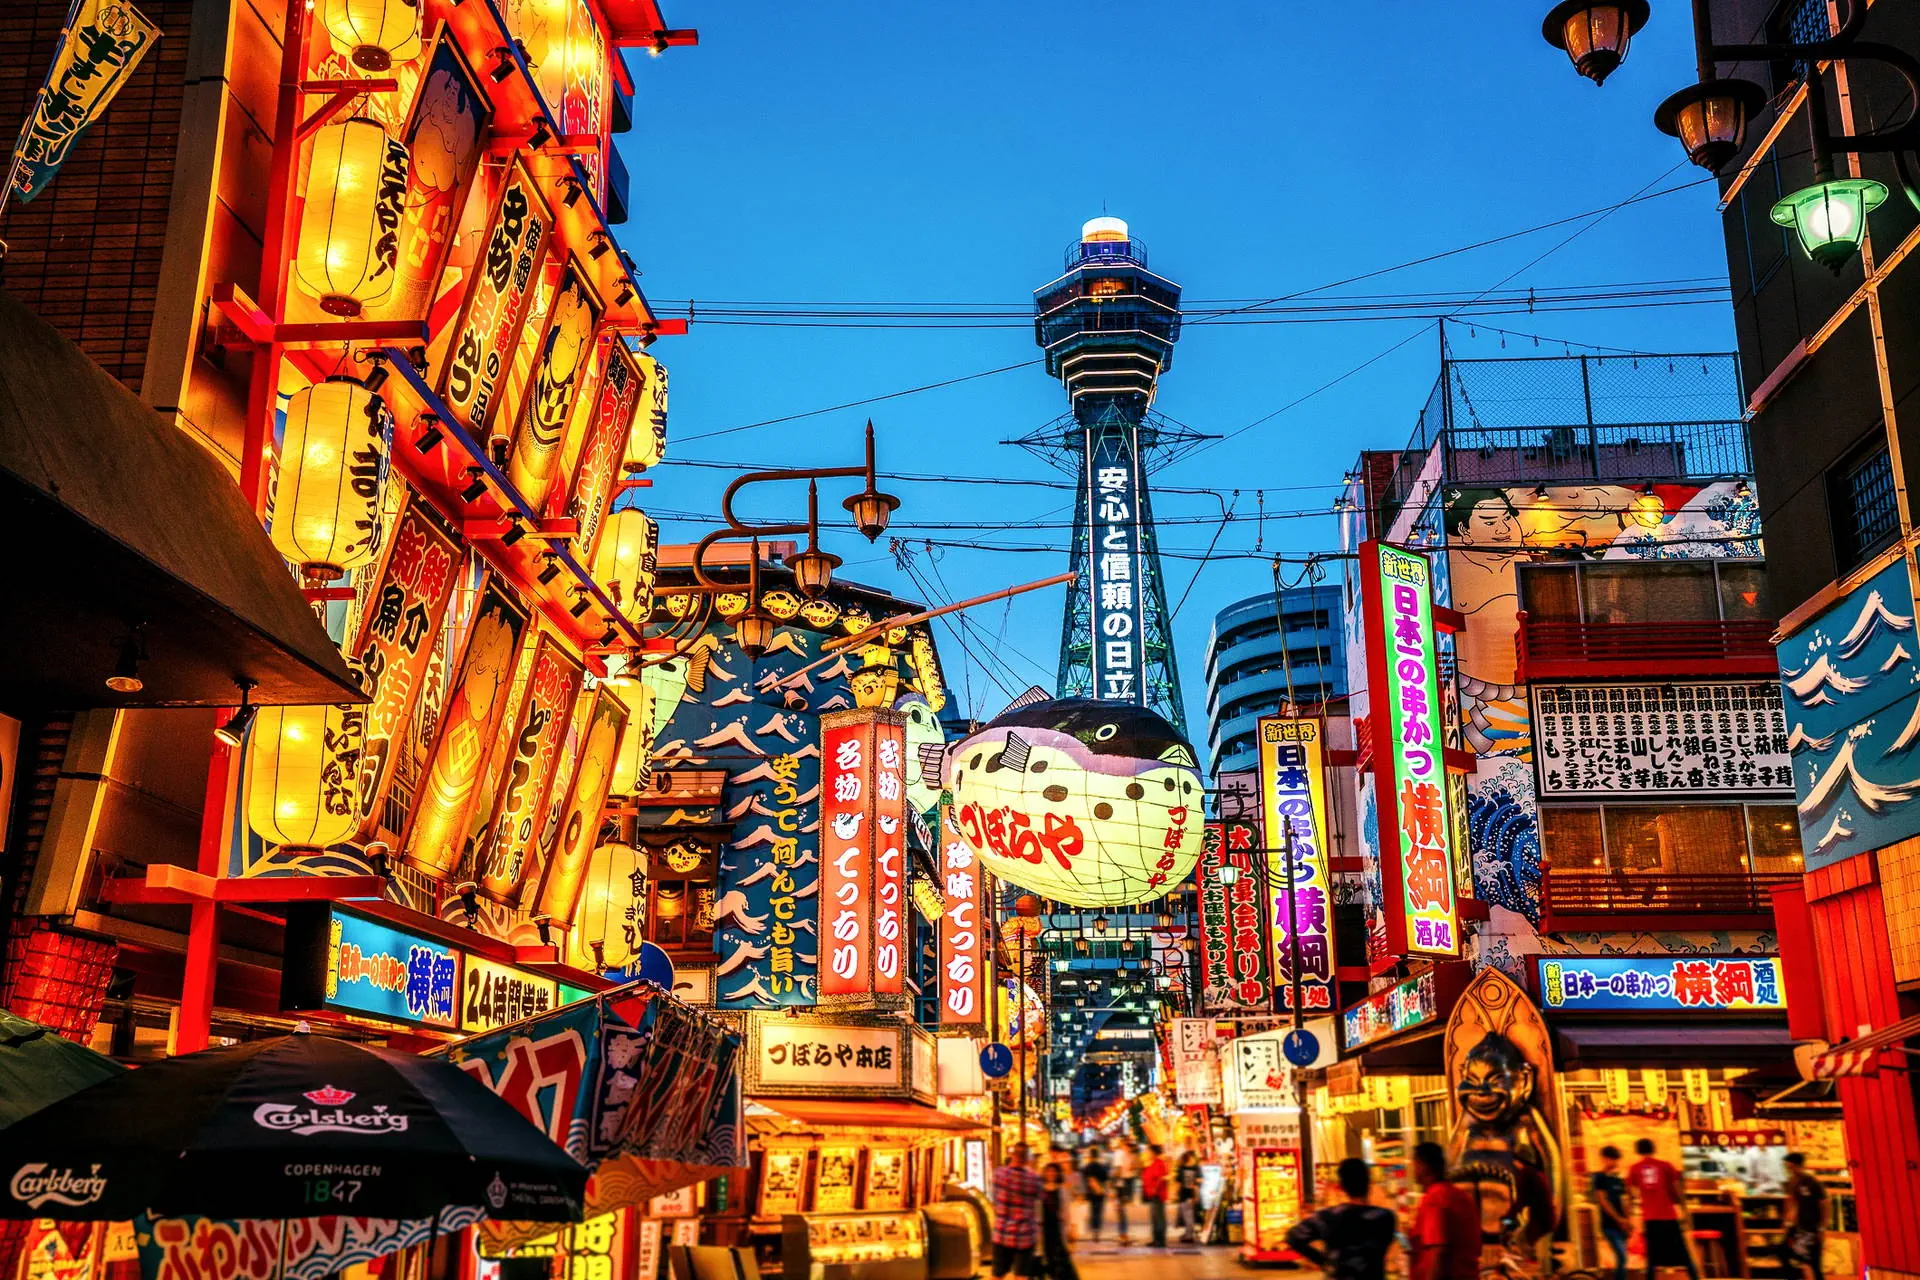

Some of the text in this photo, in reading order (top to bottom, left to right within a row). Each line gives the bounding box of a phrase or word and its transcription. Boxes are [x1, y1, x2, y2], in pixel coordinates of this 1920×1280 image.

[1098, 467, 1136, 704] 安心と信頼の日立
[1264, 722, 1316, 742] 新世界
[1382, 552, 1453, 948] 新世界 日本一の串かつ 横綱 酒処
[1545, 739, 1562, 789] もち
[1562, 738, 1581, 789] うずら玉子
[1579, 738, 1599, 788] 紅しょうが
[1596, 738, 1615, 789] にんにく
[1614, 738, 1633, 788] 玉ねぎ
[1631, 737, 1651, 788] 山芋
[1649, 737, 1668, 788] しし唐
[1666, 736, 1687, 787] れんこん
[1683, 736, 1704, 787] 銀杏
[1702, 736, 1721, 787] 白ねぎ
[1719, 735, 1739, 787] さつま芋
[1737, 735, 1757, 786] じゃが芋
[1754, 735, 1775, 786] 茄子
[1772, 734, 1792, 786] 椎茸
[832, 740, 862, 980] 名物 てっちり
[878, 738, 901, 980] 名物 てっちり
[960, 801, 1084, 871] づぼらや
[1147, 804, 1189, 889] づぼらや
[770, 752, 800, 995] 安うて何んでも旨い
[945, 841, 975, 1017] 珍味てっちり
[1275, 888, 1330, 983] 横綱
[339, 943, 407, 993] 日本一の串かつ
[406, 945, 456, 1022] 横綱
[468, 967, 550, 1026] 24時間営業
[1545, 961, 1779, 1007] 新世界 日本一の串かつ 横綱 酒処
[768, 1043, 892, 1070] づぼらや本店
[253, 1103, 409, 1136] Carlsberg
[10, 1163, 107, 1209] Carlsberg
[284, 1163, 382, 1177] COPENHAGEN
[303, 1180, 362, 1203] 1847
